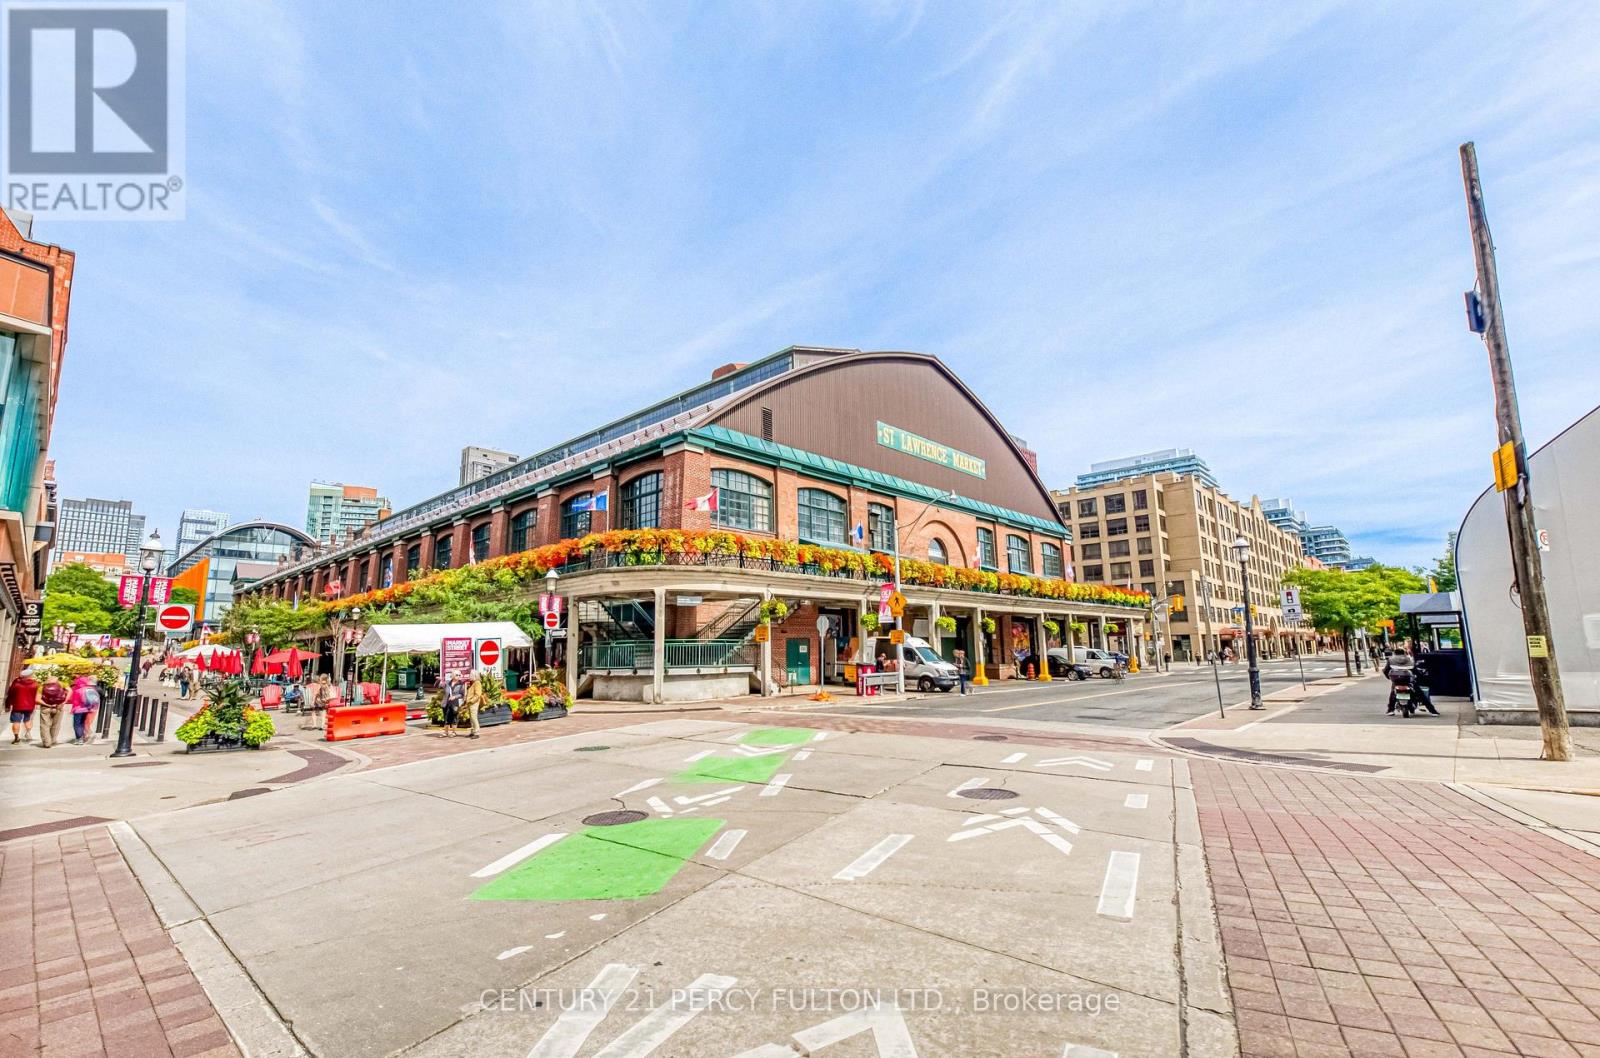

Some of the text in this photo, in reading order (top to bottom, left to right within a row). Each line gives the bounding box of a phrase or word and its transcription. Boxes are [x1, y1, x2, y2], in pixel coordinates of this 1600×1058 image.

[883, 427, 982, 476] ST LAWRENCE MARKET
